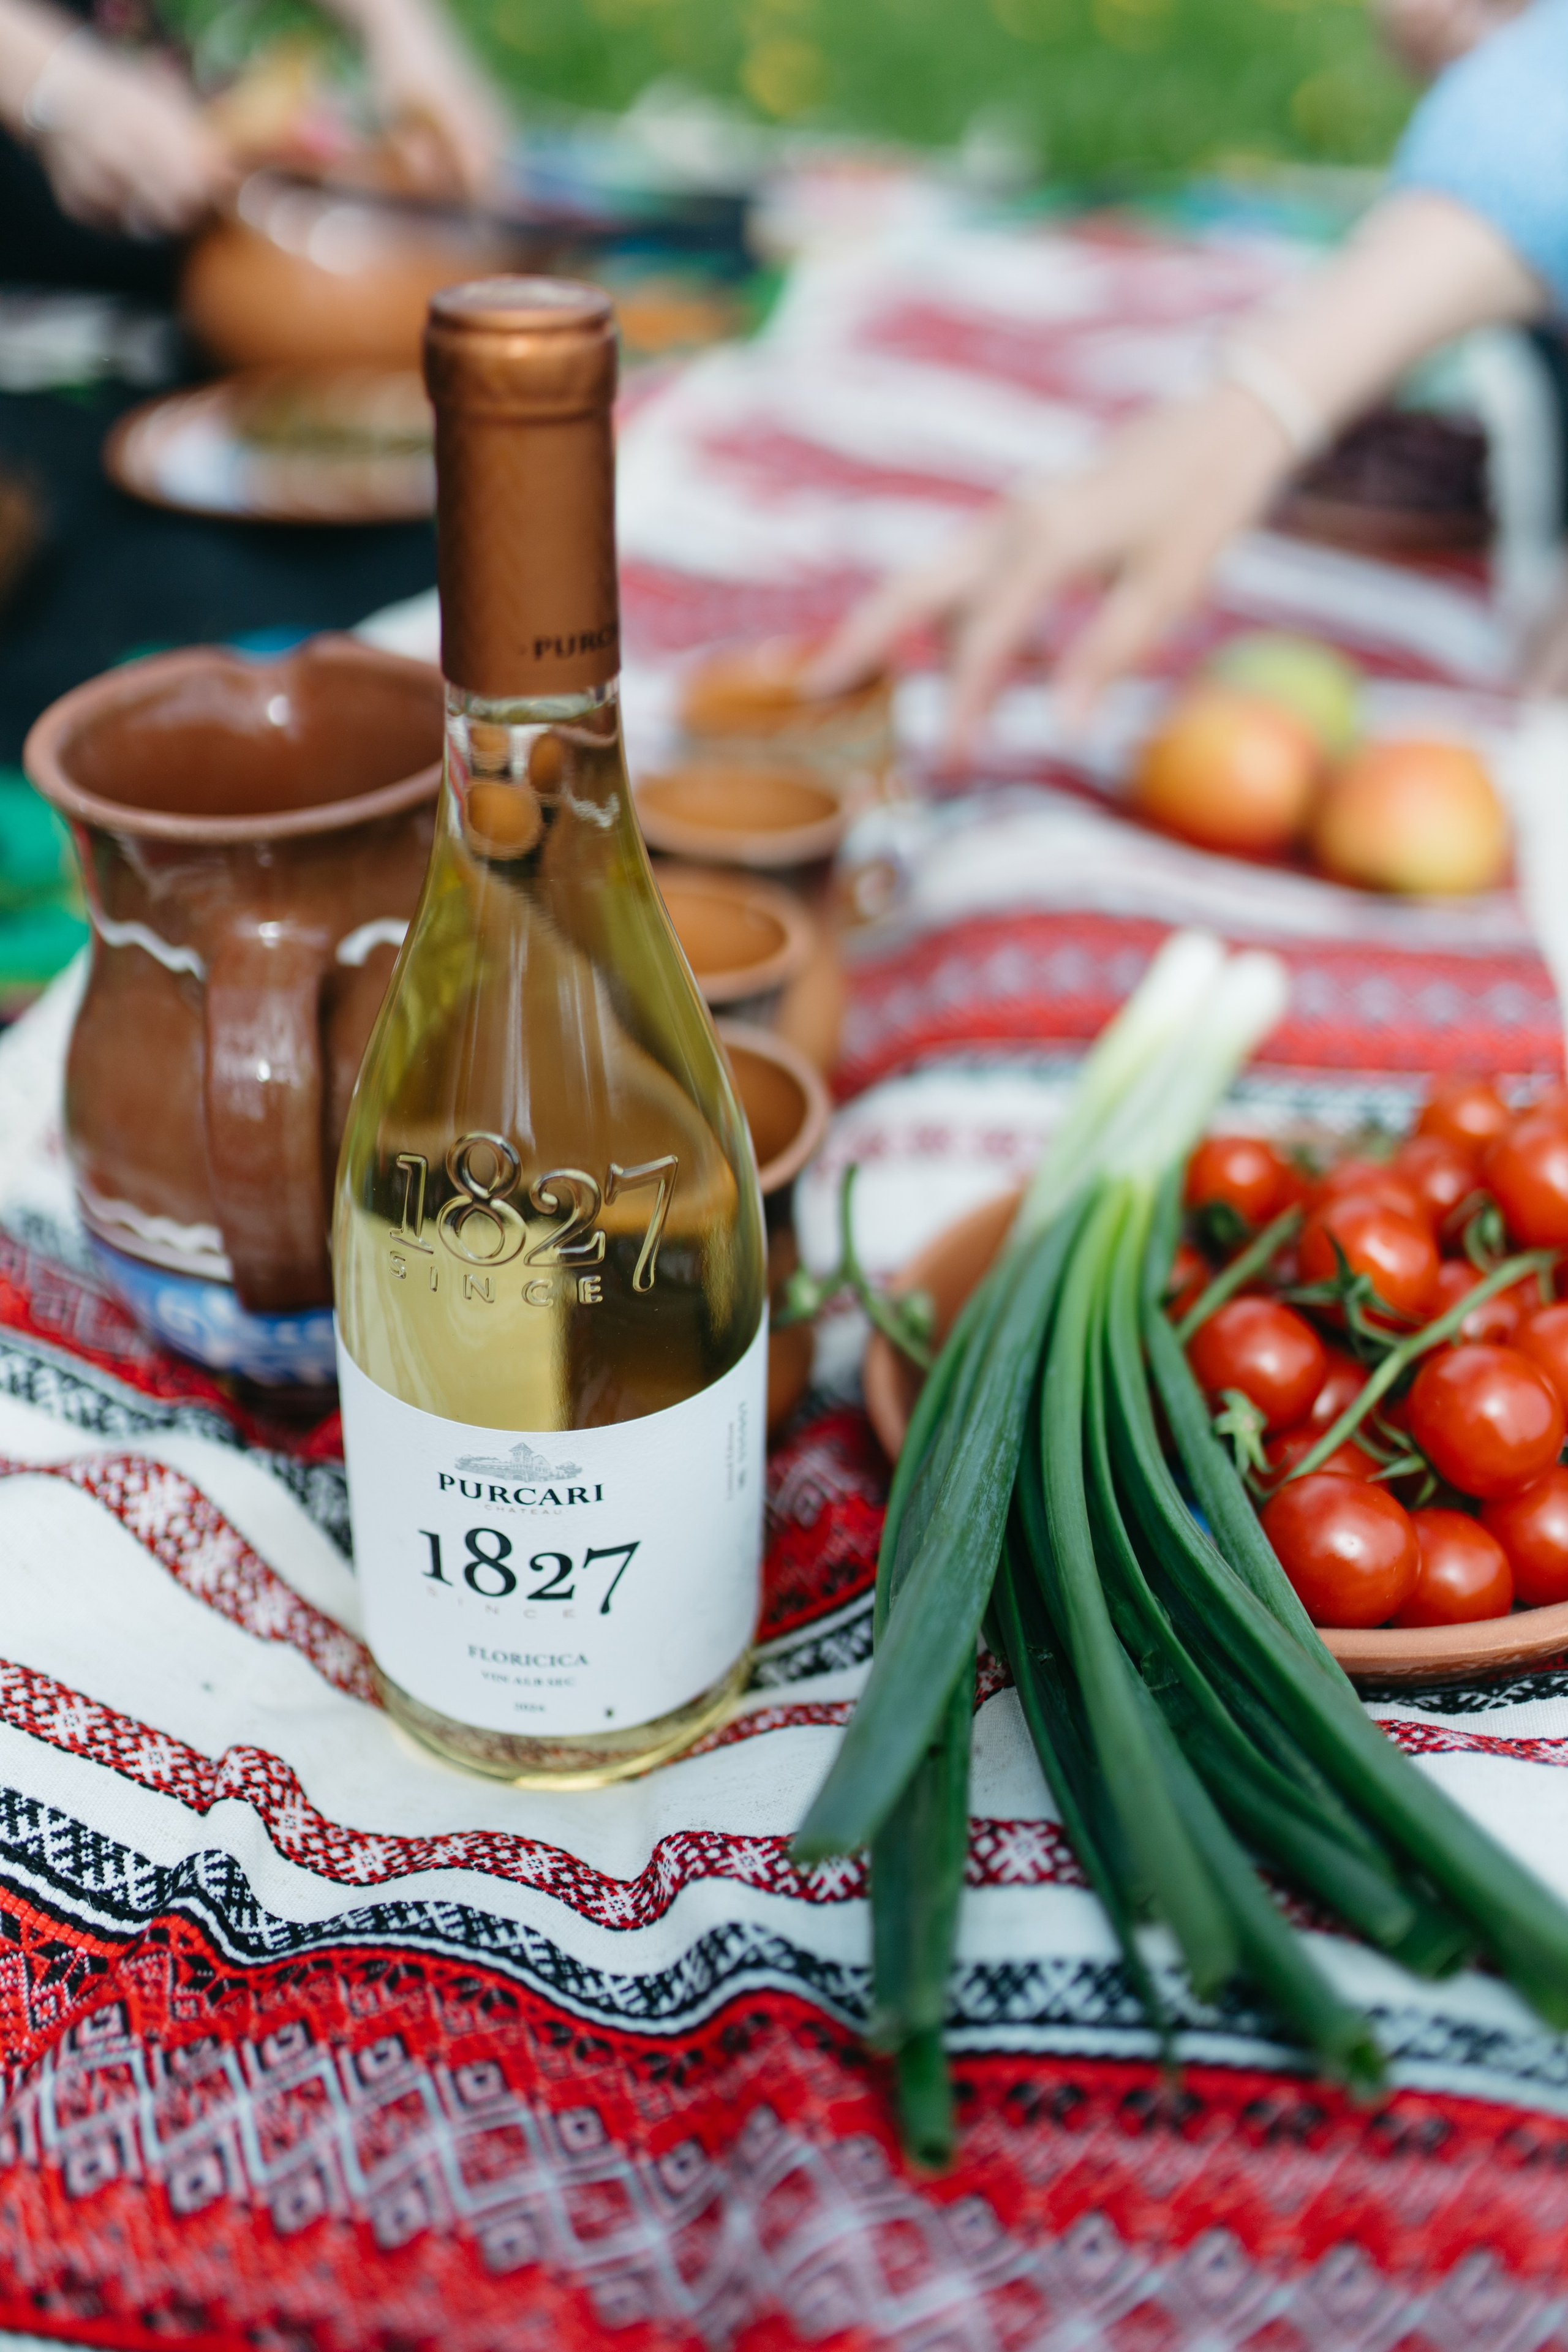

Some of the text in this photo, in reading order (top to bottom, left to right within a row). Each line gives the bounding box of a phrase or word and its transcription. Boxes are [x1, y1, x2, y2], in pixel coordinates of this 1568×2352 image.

[389, 1131, 679, 1292] 1827
[388, 1251, 604, 1307] SINCE
[437, 1472, 605, 1506] PURCARI
[418, 1528, 641, 1615] 1827
[426, 1585, 575, 1619] SINCE
[468, 1645, 589, 1667] FLORICICA
